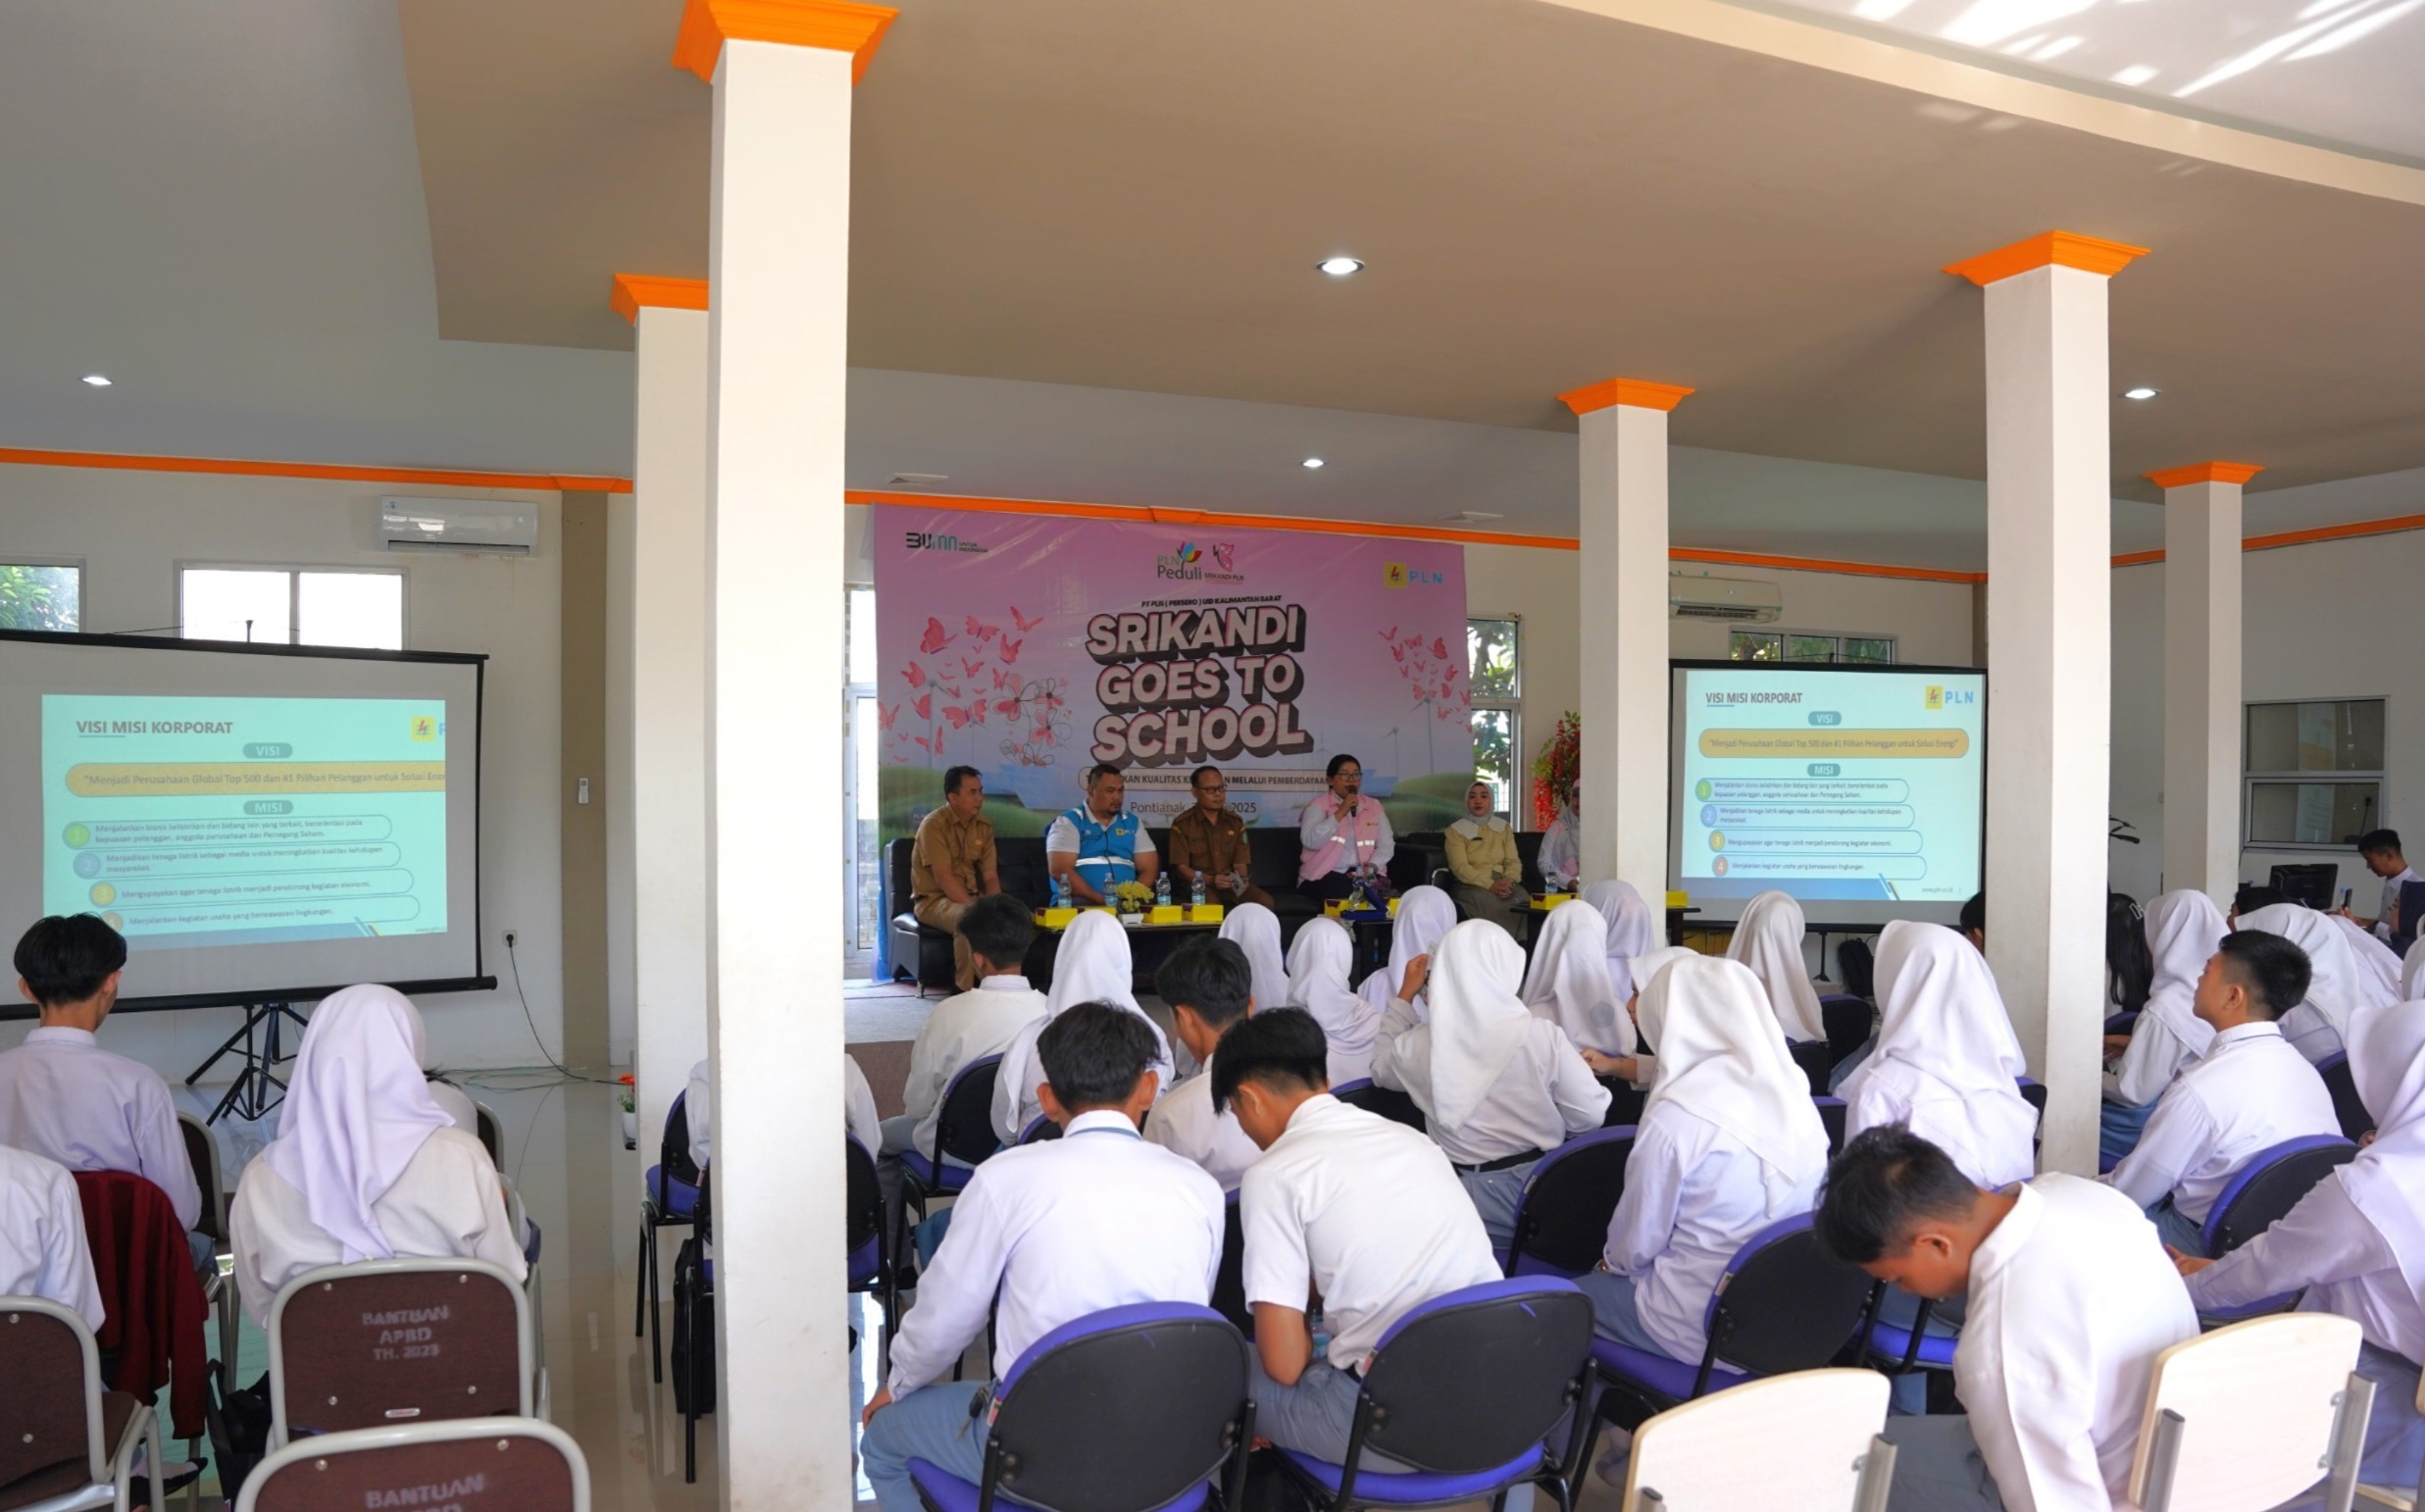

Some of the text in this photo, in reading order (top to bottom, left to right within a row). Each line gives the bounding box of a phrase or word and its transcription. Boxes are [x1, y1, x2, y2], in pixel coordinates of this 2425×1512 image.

[1157, 554, 1180, 566] PLN
[1157, 564, 1202, 580] Peduli
[1409, 569, 1443, 584] PLN
[1215, 596, 1260, 604] KALIMANTAN
[1086, 604, 1301, 658] SRIKANDI
[1096, 653, 1297, 707] GOES TO
[1706, 692, 1803, 704] VISI MISI KORPORAT
[1945, 691, 1974, 704] PLN
[1817, 714, 1833, 724] VISI
[76, 721, 233, 734] VISI MISI KORPORAT
[1090, 702, 1306, 762] SCHOOL
[255, 746, 280, 756] VISI
[1814, 766, 1833, 775] MISI
[133, 775, 190, 784] Perusahaan
[192, 775, 223, 784] Global
[225, 775, 242, 784] Top
[243, 774, 261, 783] 500
[263, 774, 280, 783] dan
[296, 773, 326, 782] Pilihan
[329, 773, 373, 784] Pelanggan
[374, 773, 398, 781] untuk
[401, 772, 426, 781] Solusi
[1142, 775, 1181, 783] KUALITAS
[255, 803, 283, 813] MISI
[1231, 802, 1256, 813] 2025
[95, 824, 144, 833] Menjalankan
[222, 821, 245, 830] bidang
[95, 835, 132, 844] kepuasan
[206, 832, 247, 840] perusahaan
[263, 831, 298, 839] Pemegang
[106, 854, 150, 862] Menjadikan
[200, 851, 227, 859] sebagai
[273, 848, 321, 857] meningkatkan
[349, 846, 382, 855] kehidupan
[100, 889, 107, 899] 3
[122, 890, 177, 899] Mengupayakan
[244, 885, 272, 894] menjadi
[273, 884, 310, 893] pendorong
[312, 883, 339, 891] kegiatan
[129, 917, 177, 926] Menjalankan
[178, 915, 209, 924] kegiatan
[233, 913, 251, 921] yang
[251, 910, 294, 919] berwawasan
[362, 1305, 449, 1325] BANTUAN
[379, 1327, 432, 1345] APBD
[365, 1472, 485, 1509] BANTUAN
